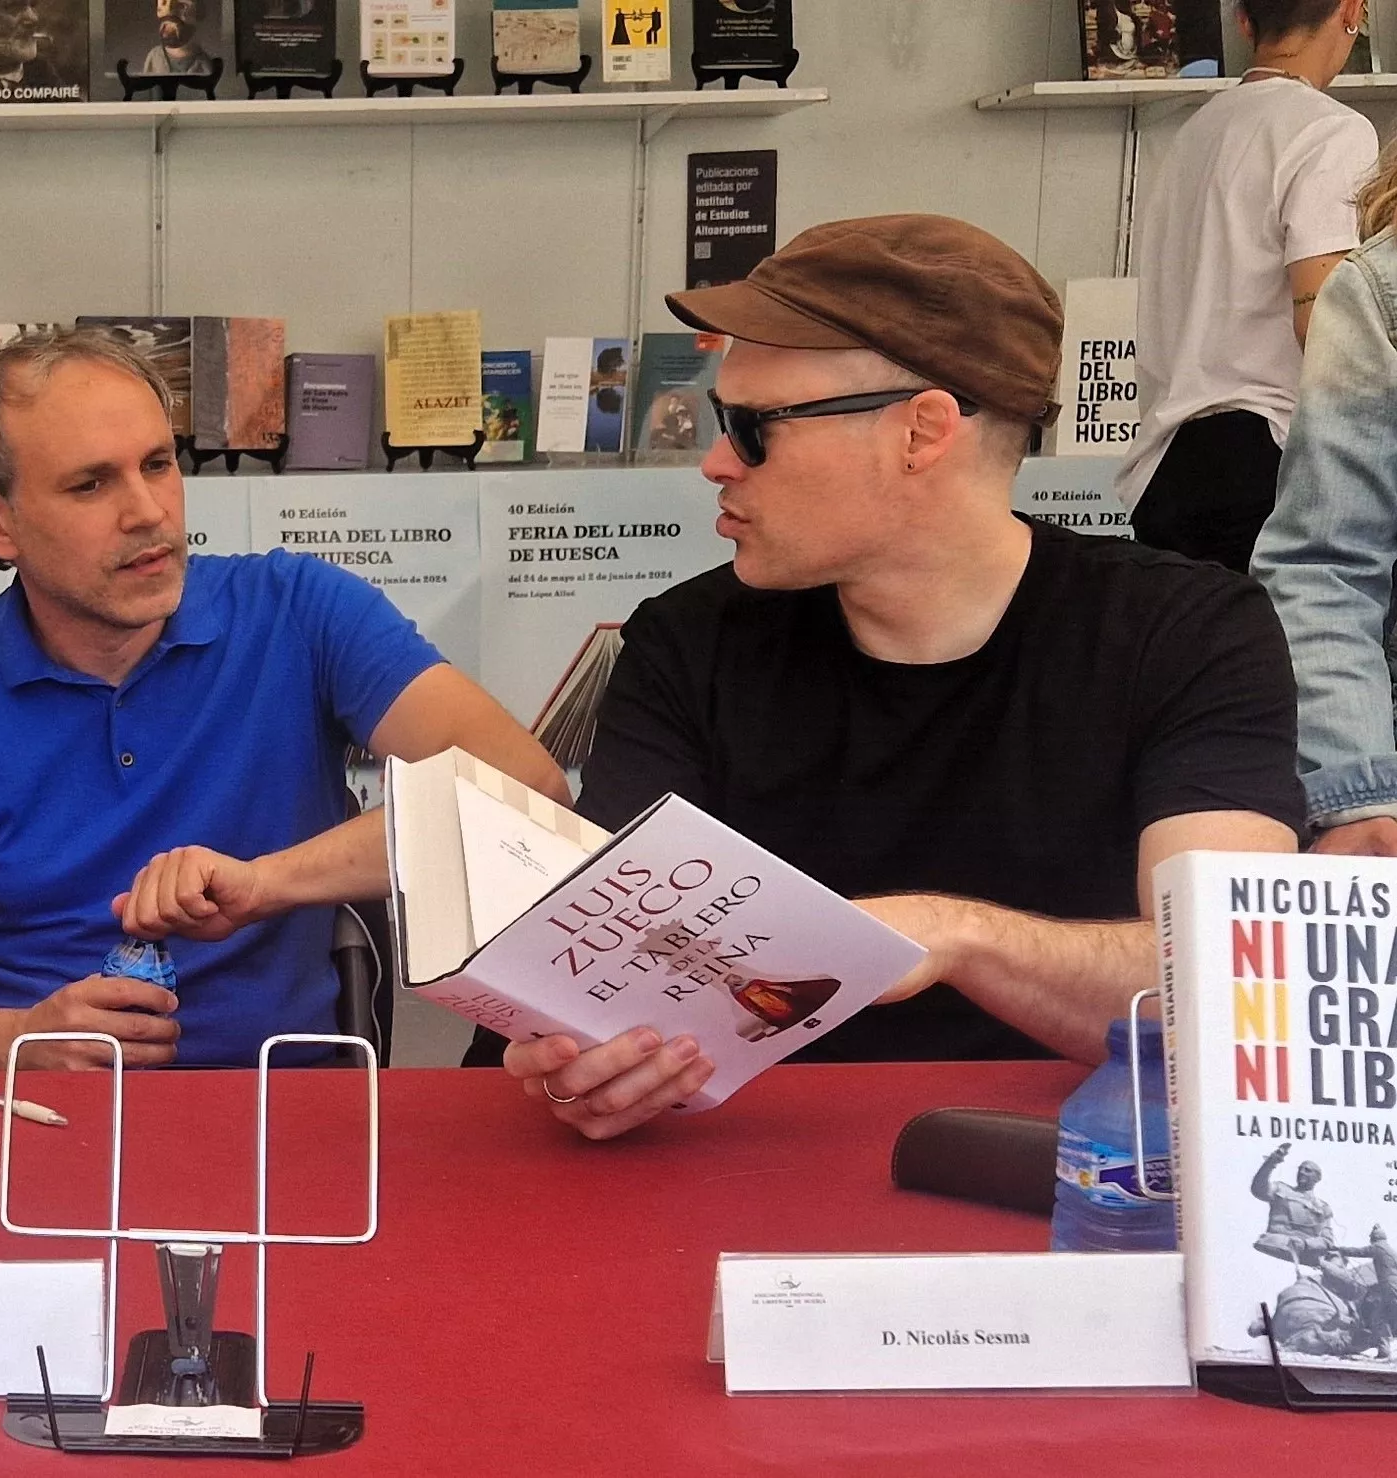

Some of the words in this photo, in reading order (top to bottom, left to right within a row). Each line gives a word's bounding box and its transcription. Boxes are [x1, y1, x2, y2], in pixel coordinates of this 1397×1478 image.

[14, 83, 80, 99] COMPAIRÉ
[696, 167, 759, 178] Publicaciones
[695, 182, 733, 193] editadas
[736, 181, 752, 192] por
[696, 196, 734, 207] Instituto
[695, 211, 707, 221] de
[710, 209, 750, 221] Estudios
[1080, 340, 1136, 360] FERIA
[1079, 361, 1115, 381] DEL
[1078, 382, 1137, 401] LIBRO
[413, 396, 472, 409] ALAZET
[1076, 403, 1102, 422] DE
[1076, 422, 1141, 443] HUESC
[1031, 491, 1048, 501] 40
[1052, 490, 1101, 501] Edición
[279, 509, 295, 519] 40
[299, 508, 347, 519] Edición
[508, 504, 523, 515] 40
[527, 503, 575, 514] Edición
[1099, 513, 1132, 526] DE
[281, 530, 340, 544] FERIA
[347, 529, 386, 543] DEL
[391, 528, 452, 542] LIBRO
[508, 526, 569, 540] FERIA
[573, 525, 613, 539] DEL
[618, 523, 681, 538] LIBRO
[508, 549, 534, 562] DE
[538, 546, 620, 561] HUESCA
[383, 576, 408, 585] junio
[423, 575, 447, 583] 2024
[508, 575, 521, 583] del
[537, 574, 548, 582] de
[551, 575, 574, 583] mayo
[608, 573, 634, 582] junio
[635, 572, 646, 580] de
[648, 571, 672, 579] 2024
[546, 859, 652, 936] LUIS
[1230, 875, 1391, 918] NICOLÁS
[551, 858, 713, 977] ZUECO
[587, 979, 629, 1002] EL
[621, 875, 761, 974] TABLERO
[673, 953, 697, 972] DE
[695, 937, 722, 957] LA
[1231, 919, 1286, 980] NI
[661, 933, 774, 1003] REINA
[471, 993, 522, 1018] LUIS
[1233, 981, 1288, 1042] NI
[1235, 1043, 1290, 1103] NI
[1236, 1114, 1262, 1137] LA
[1270, 1116, 1395, 1146] DICTADURA
[882, 1331, 902, 1346] D.
[906, 1330, 970, 1346] Nicolás
[974, 1330, 1030, 1345] Sesma
